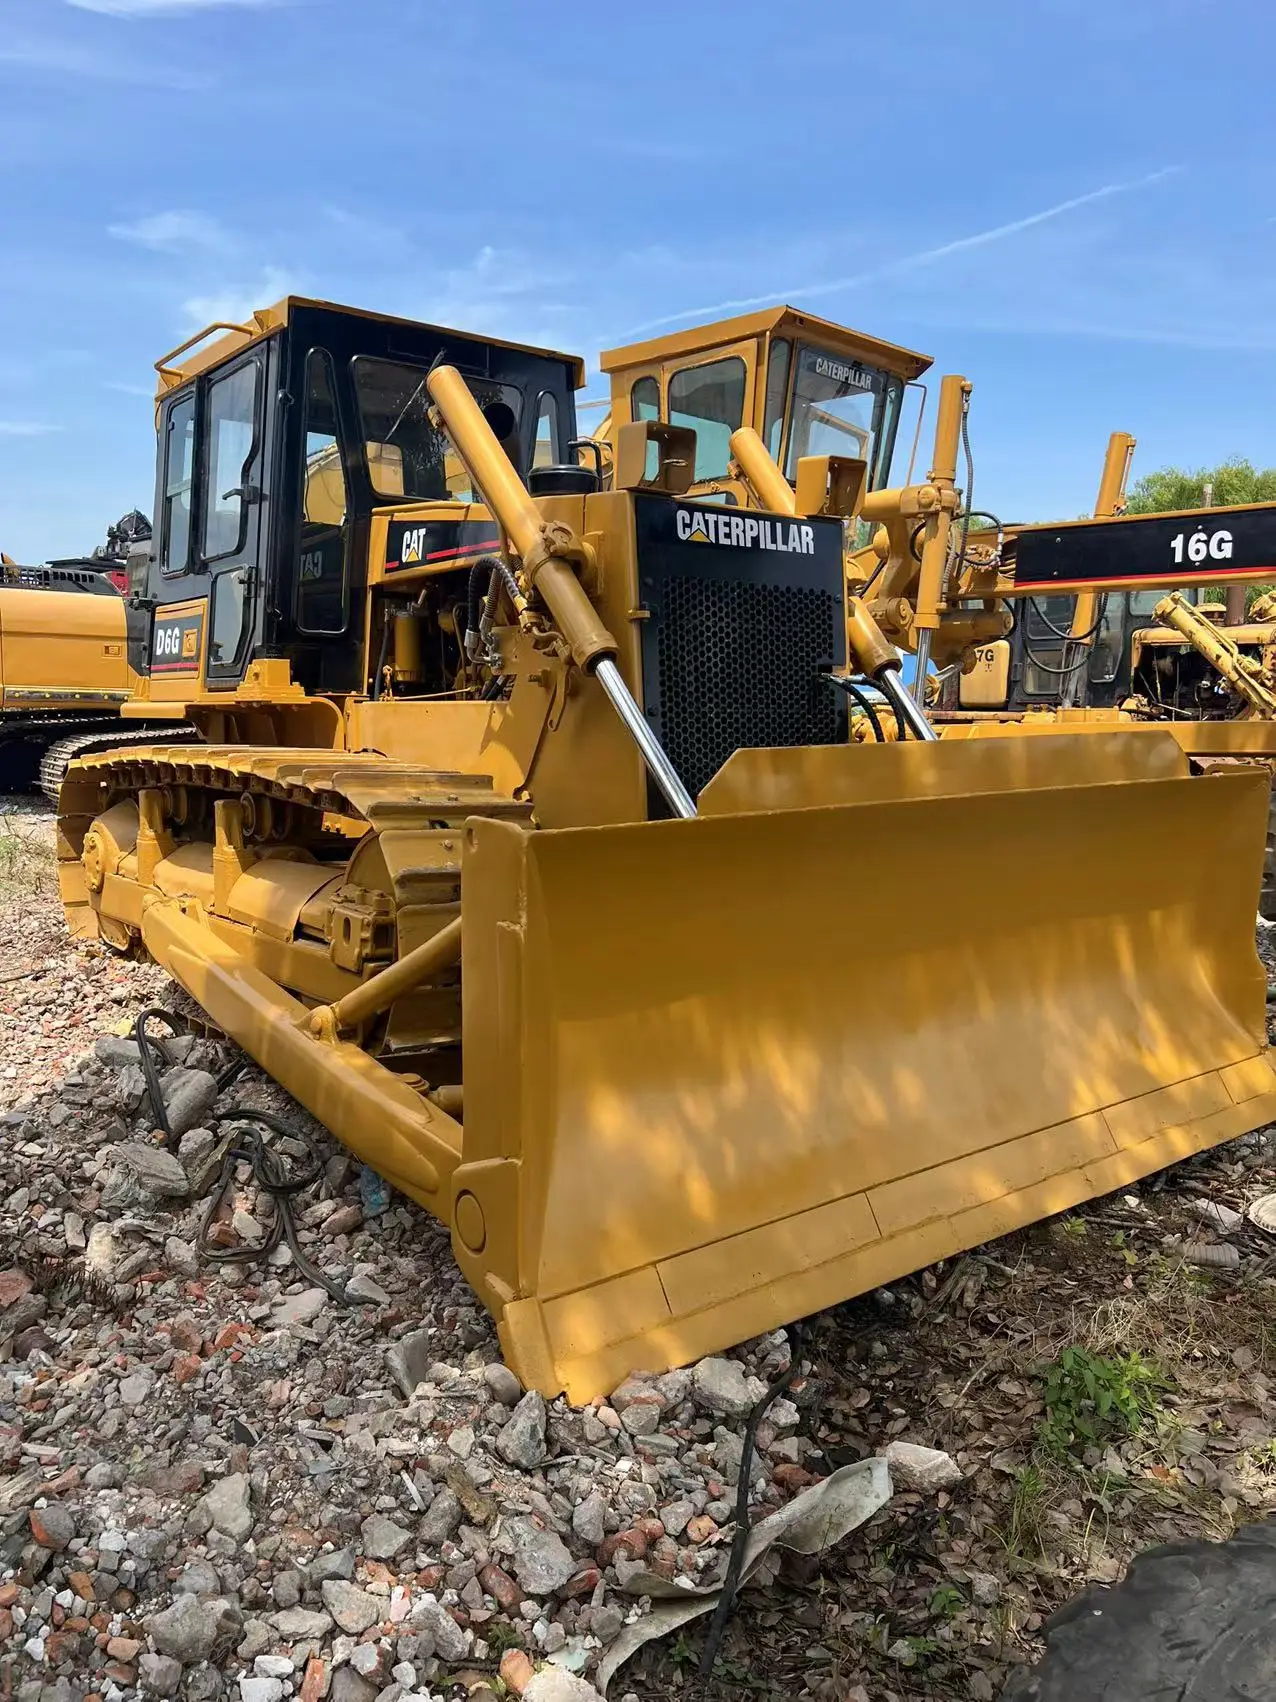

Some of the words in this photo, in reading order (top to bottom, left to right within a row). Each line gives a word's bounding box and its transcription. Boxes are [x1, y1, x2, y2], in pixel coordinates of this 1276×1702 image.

[815, 358, 872, 390] CATERPILLAR
[401, 528, 426, 563] CAT
[676, 509, 815, 555] CATERPILLAR
[1170, 530, 1233, 563] 16G
[156, 627, 180, 656] D6G
